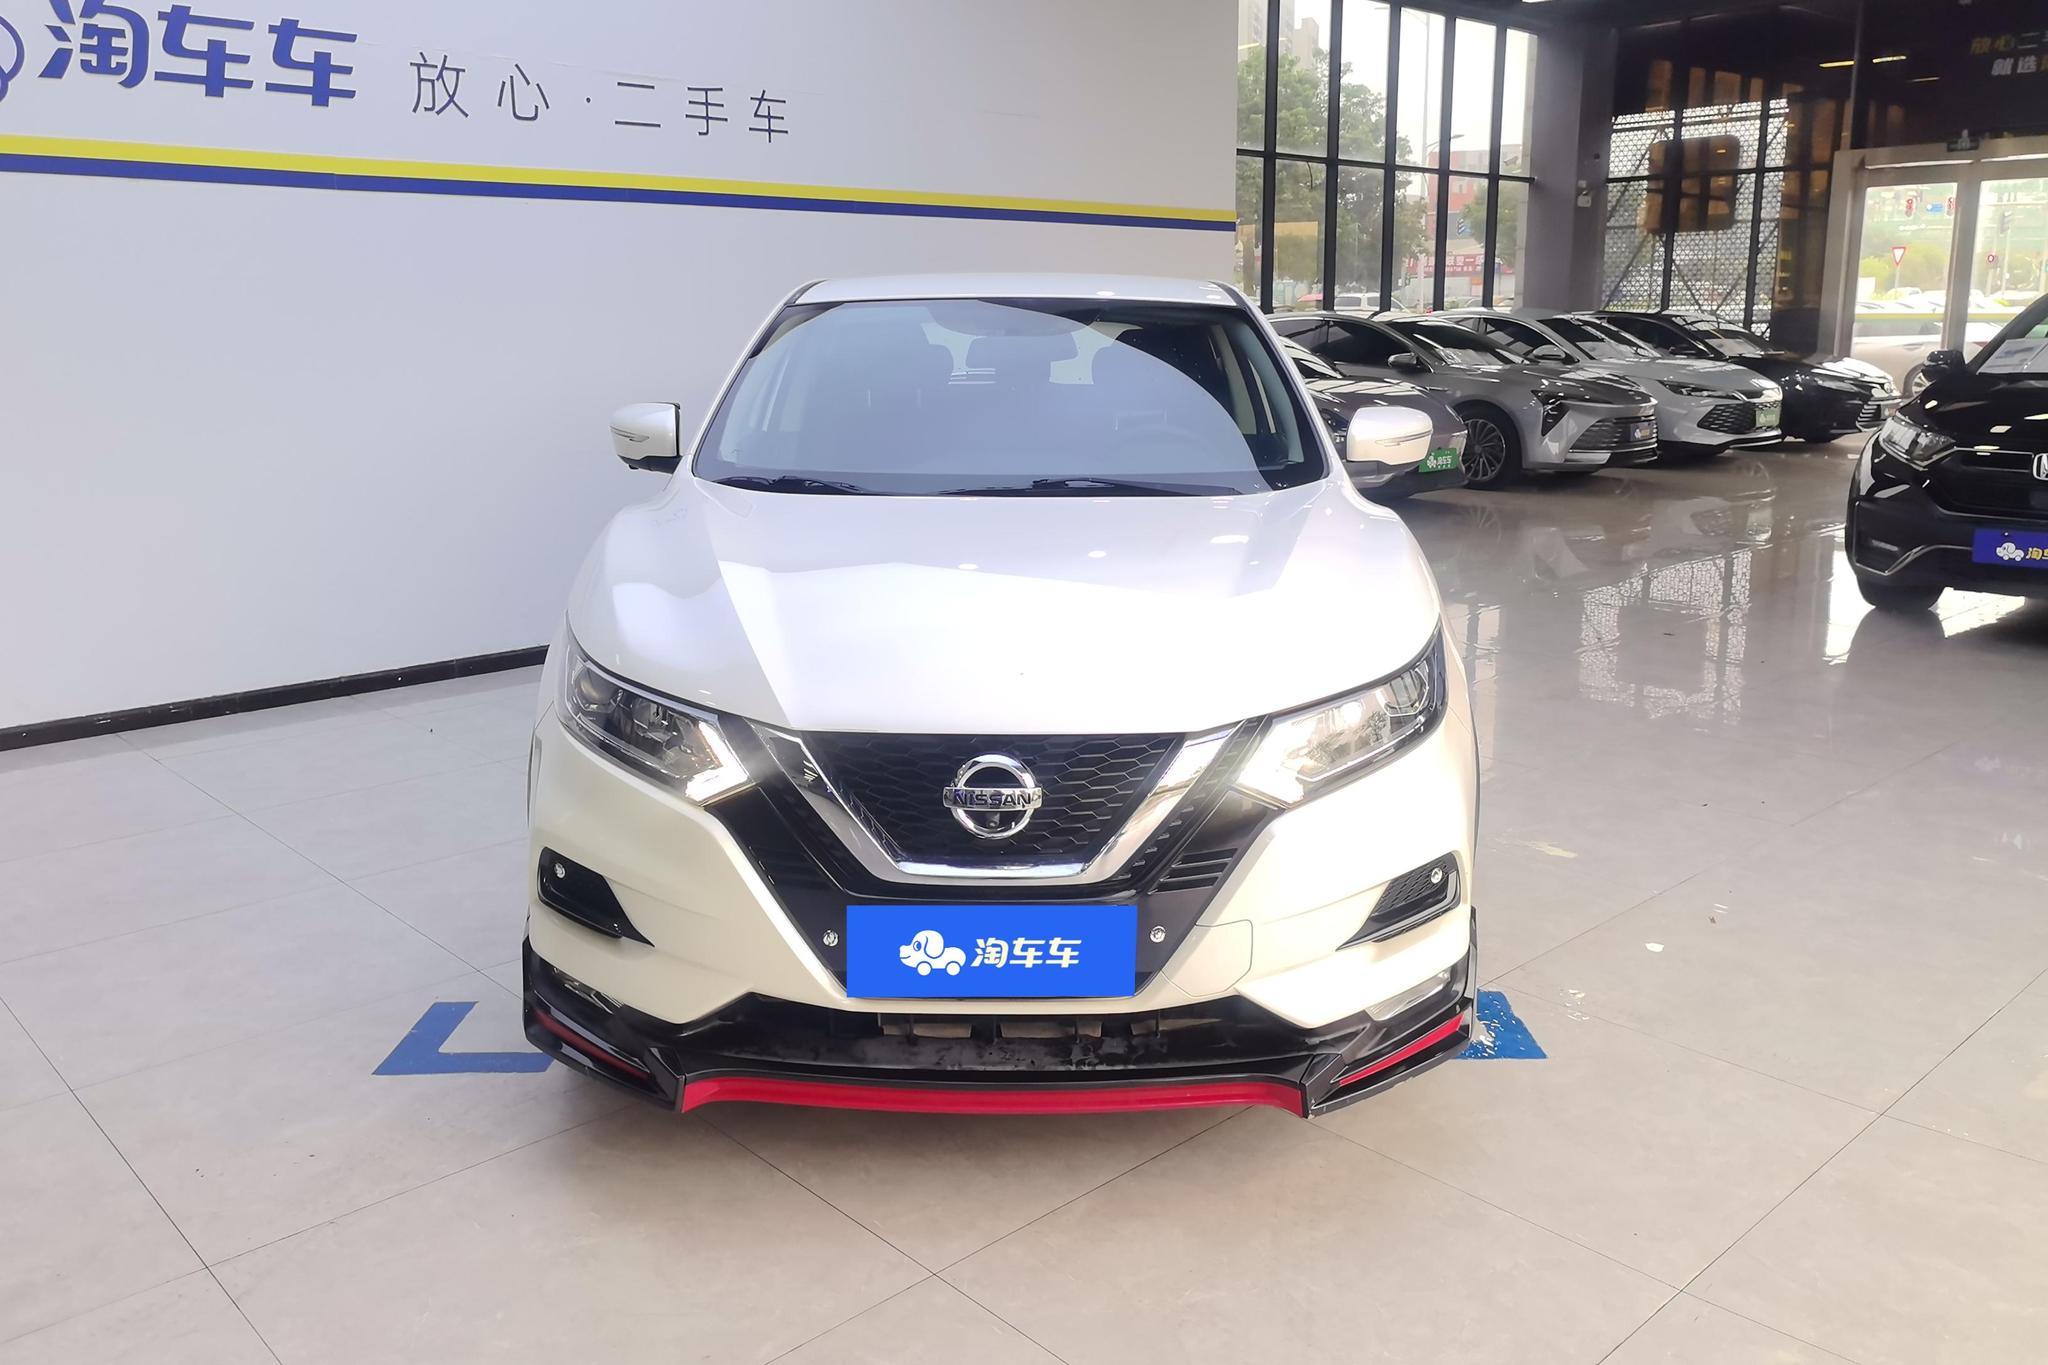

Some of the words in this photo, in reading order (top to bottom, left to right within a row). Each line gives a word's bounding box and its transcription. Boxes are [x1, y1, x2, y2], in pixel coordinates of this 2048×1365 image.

[38, 0, 358, 107] 淘车车
[953, 790, 1032, 808] NISSAN
